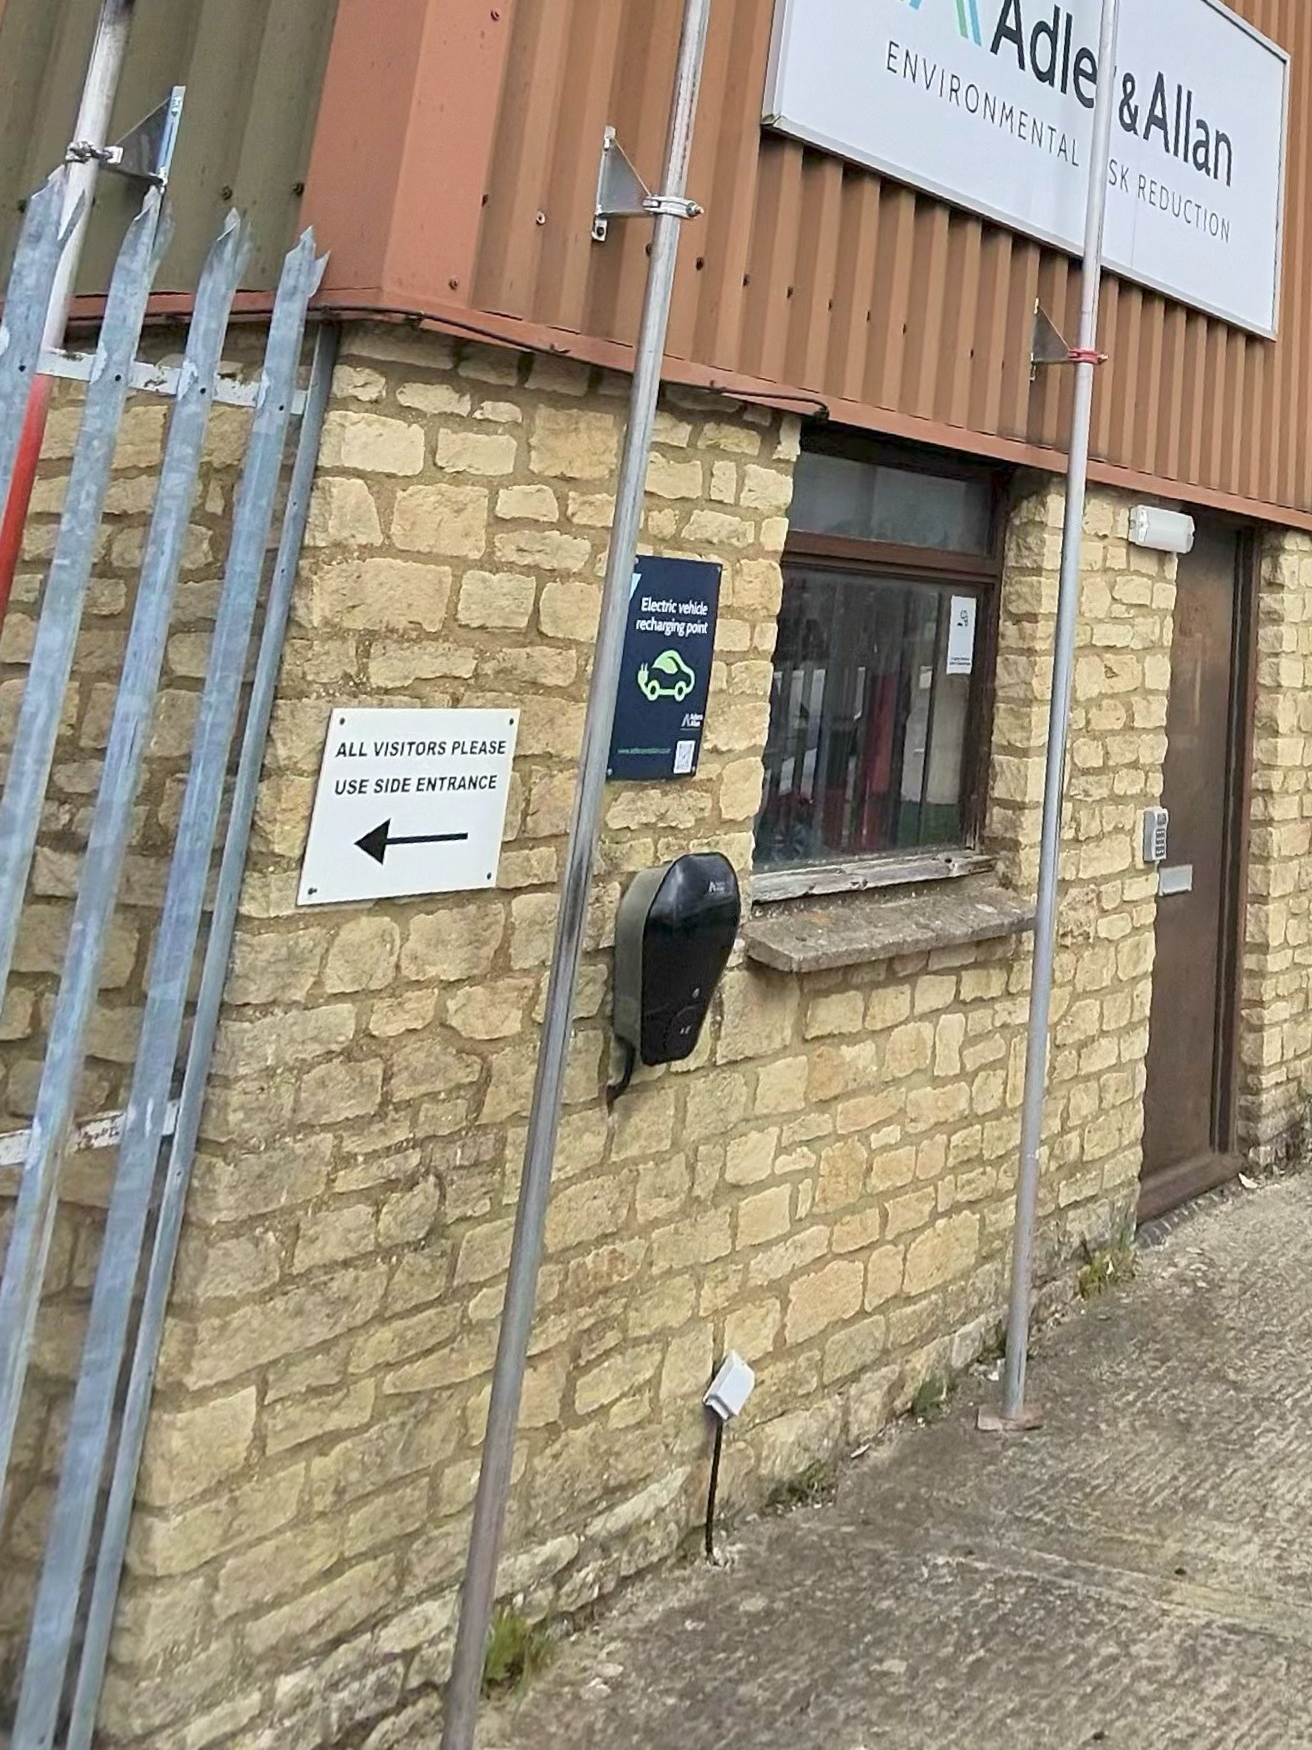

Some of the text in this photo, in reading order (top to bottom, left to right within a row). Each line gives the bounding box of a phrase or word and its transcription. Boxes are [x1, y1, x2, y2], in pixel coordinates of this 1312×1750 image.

[886, 40, 1080, 167] ENVIRONMENTAL
[1137, 174, 1231, 243] REDUCTION
[641, 596, 709, 616] Electric vehicle
[635, 616, 709, 638] recharging point
[335, 740, 507, 758] ALL VISITORS PLEASE
[334, 774, 498, 796] USE SIDE ENTRANCE
